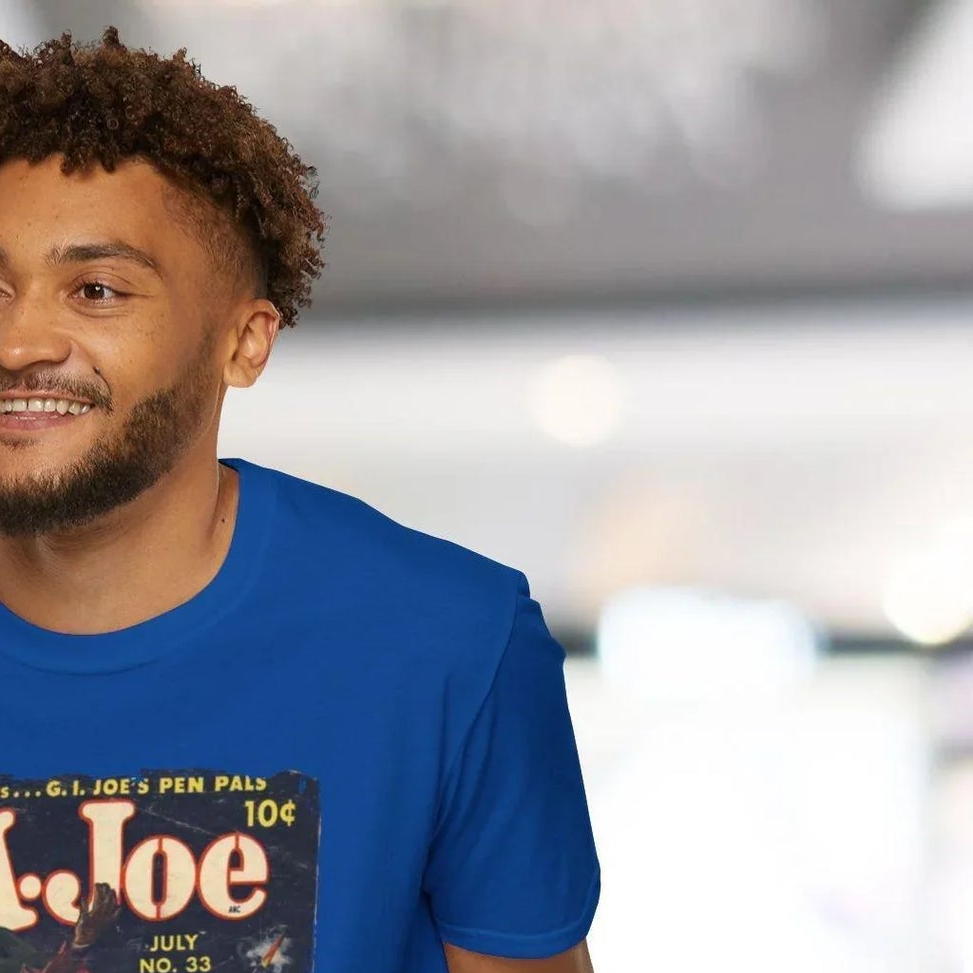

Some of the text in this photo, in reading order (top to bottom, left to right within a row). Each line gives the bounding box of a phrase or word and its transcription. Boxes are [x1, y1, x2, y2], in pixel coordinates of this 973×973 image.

[92, 777, 149, 796] JOE'S
[159, 777, 204, 794] PEN
[214, 775, 267, 792] PALS
[244, 799, 296, 828] 10¢
[149, 933, 199, 952] JULY
[185, 955, 212, 973] 33
